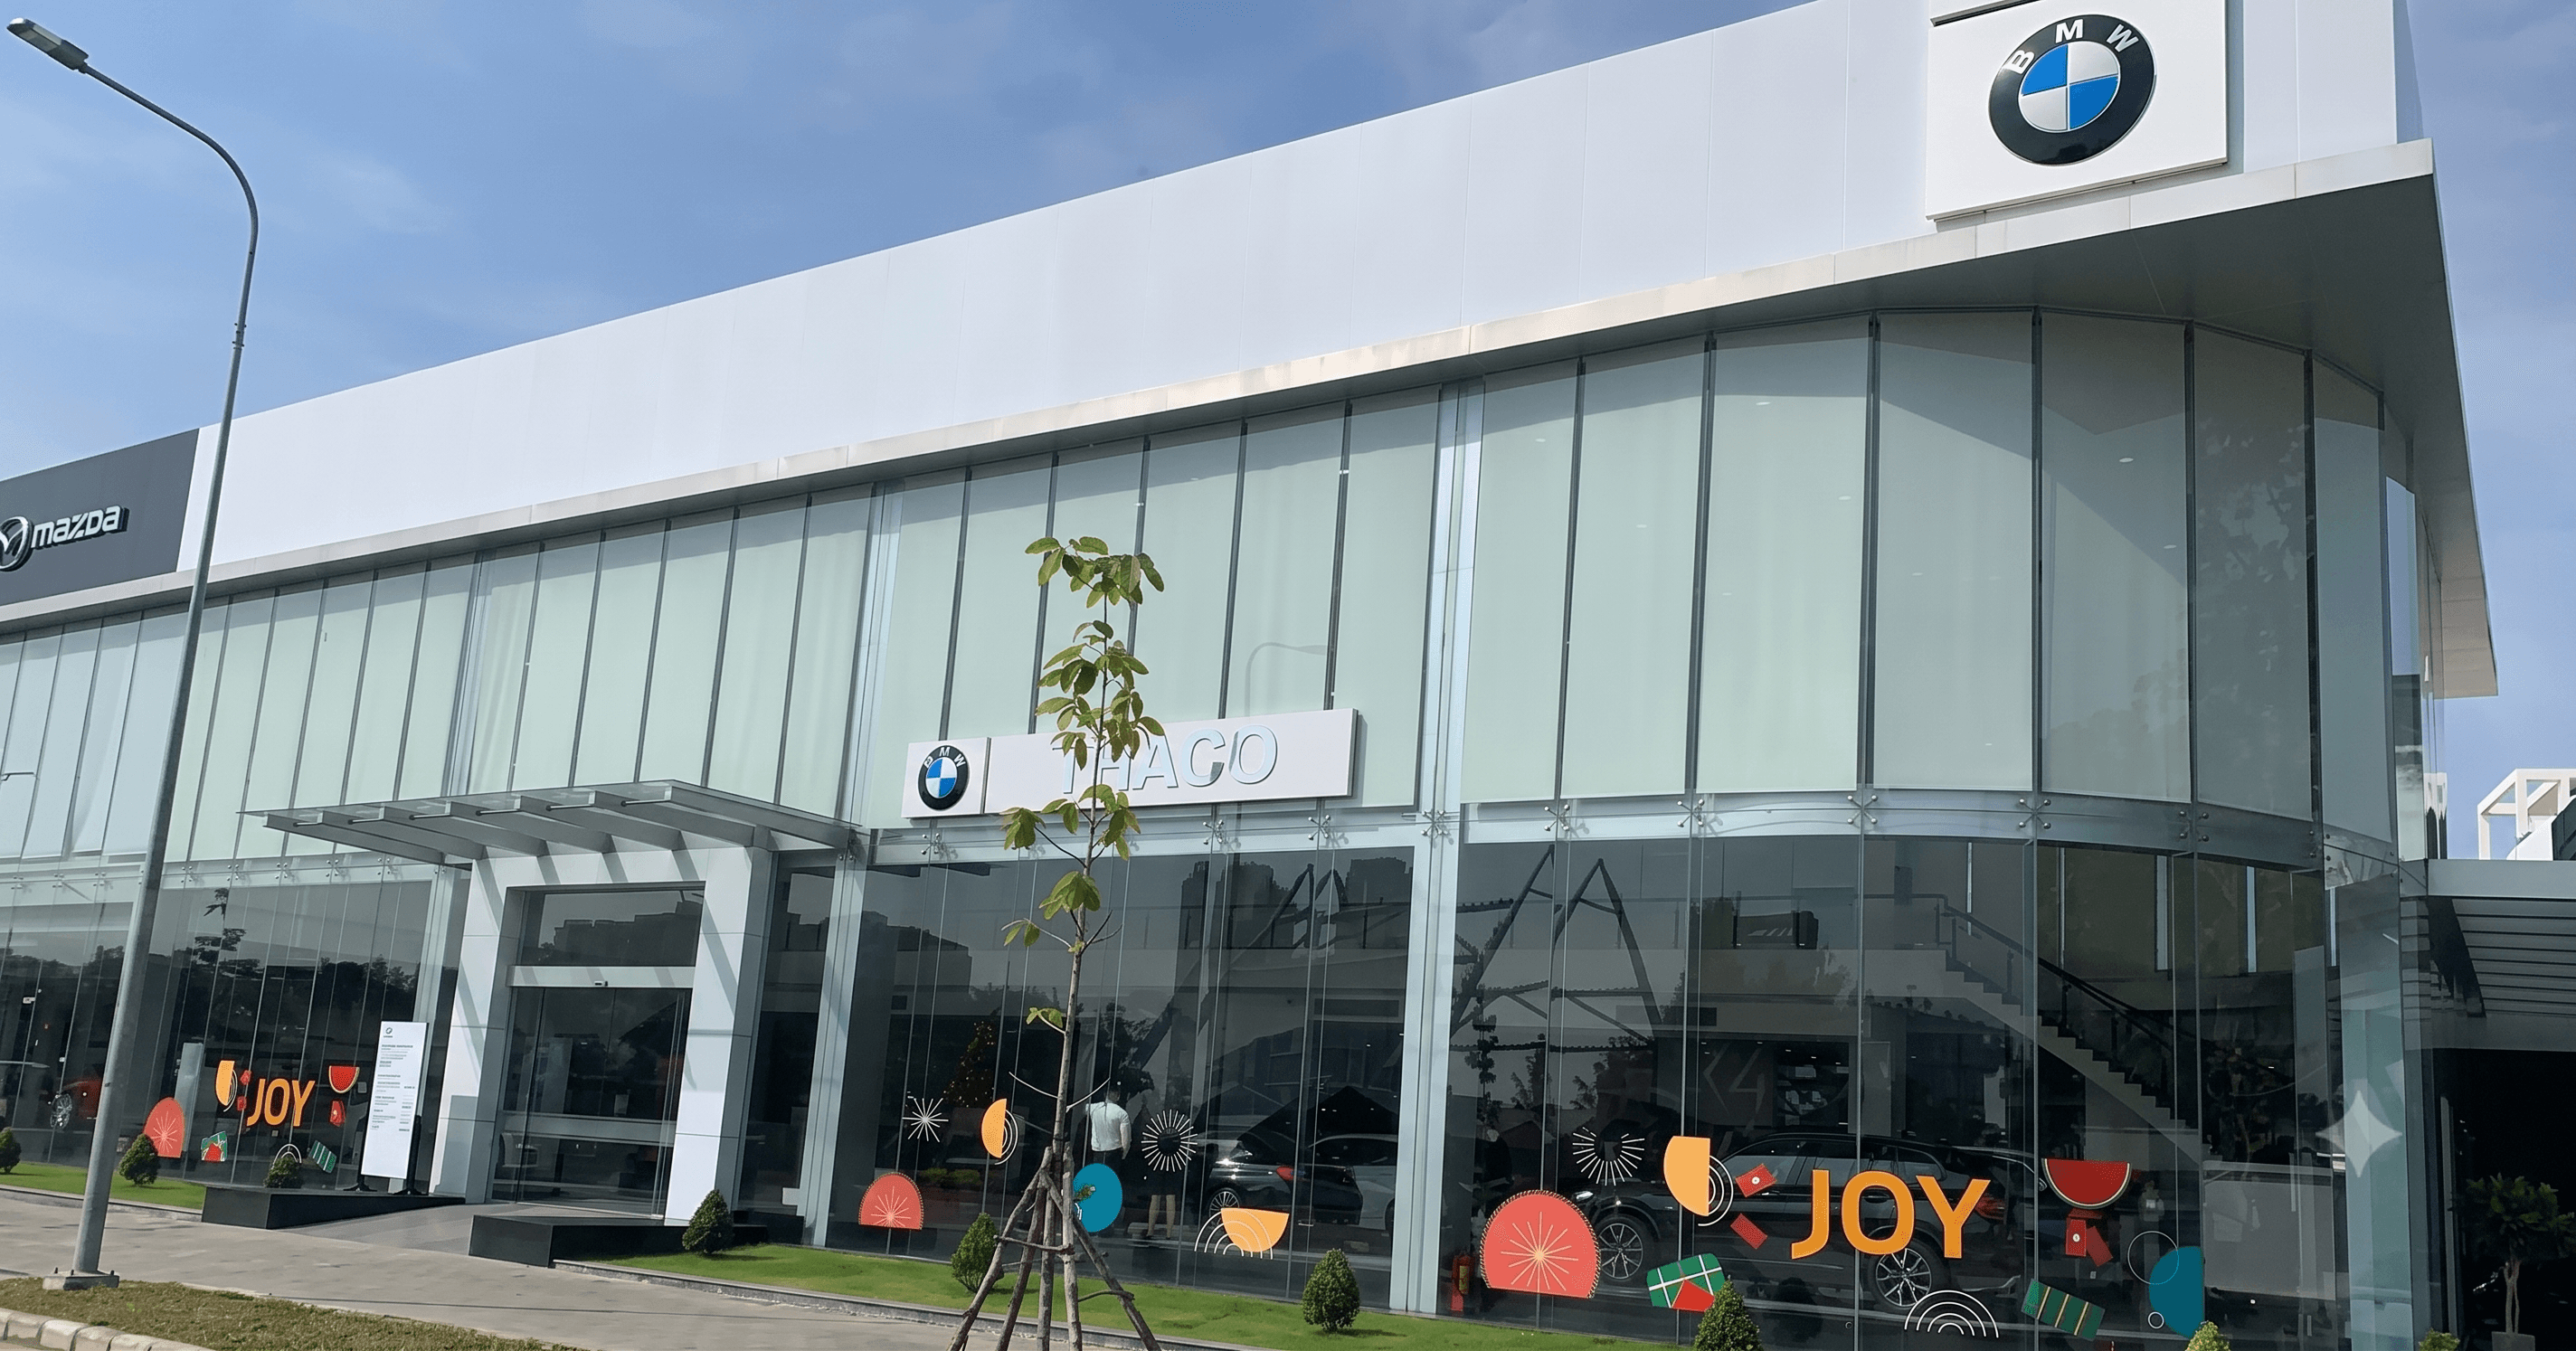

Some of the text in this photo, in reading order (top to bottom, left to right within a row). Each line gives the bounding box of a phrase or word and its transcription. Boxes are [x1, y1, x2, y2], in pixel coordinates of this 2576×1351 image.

[2001, 18, 2139, 76] BMW
[30, 505, 123, 549] mazda
[923, 746, 966, 769] BMW
[1052, 723, 1278, 794] THACO
[246, 1077, 316, 1128] JOY
[1791, 1168, 1992, 1260] JOY
